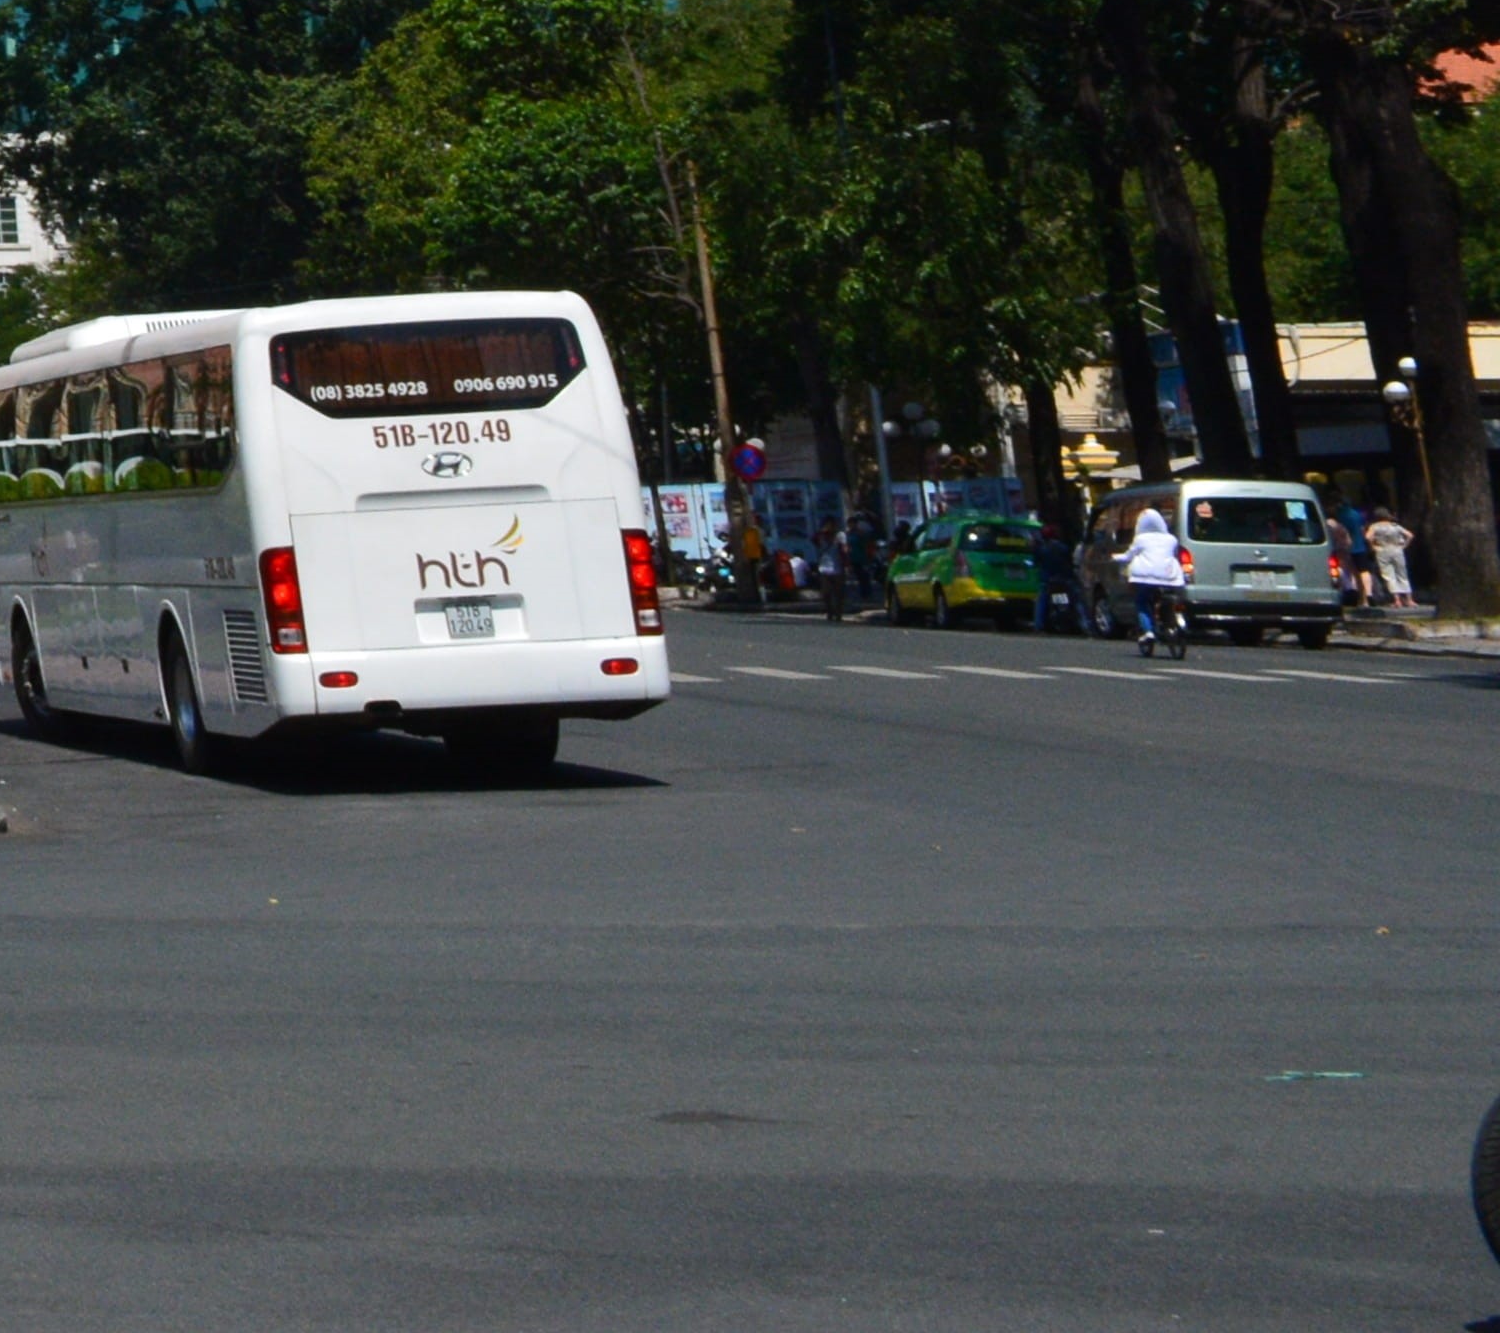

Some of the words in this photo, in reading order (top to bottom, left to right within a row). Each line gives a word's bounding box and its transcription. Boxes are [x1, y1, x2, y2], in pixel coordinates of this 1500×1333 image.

[310, 386, 342, 402] (08)
[345, 384, 384, 399] 3825
[388, 381, 428, 397] 4928
[453, 377, 493, 393] 0906
[496, 375, 526, 390] 690
[529, 374, 559, 388] 915
[372, 418, 511, 449] 51B-120.49
[456, 605, 481, 618] 51B
